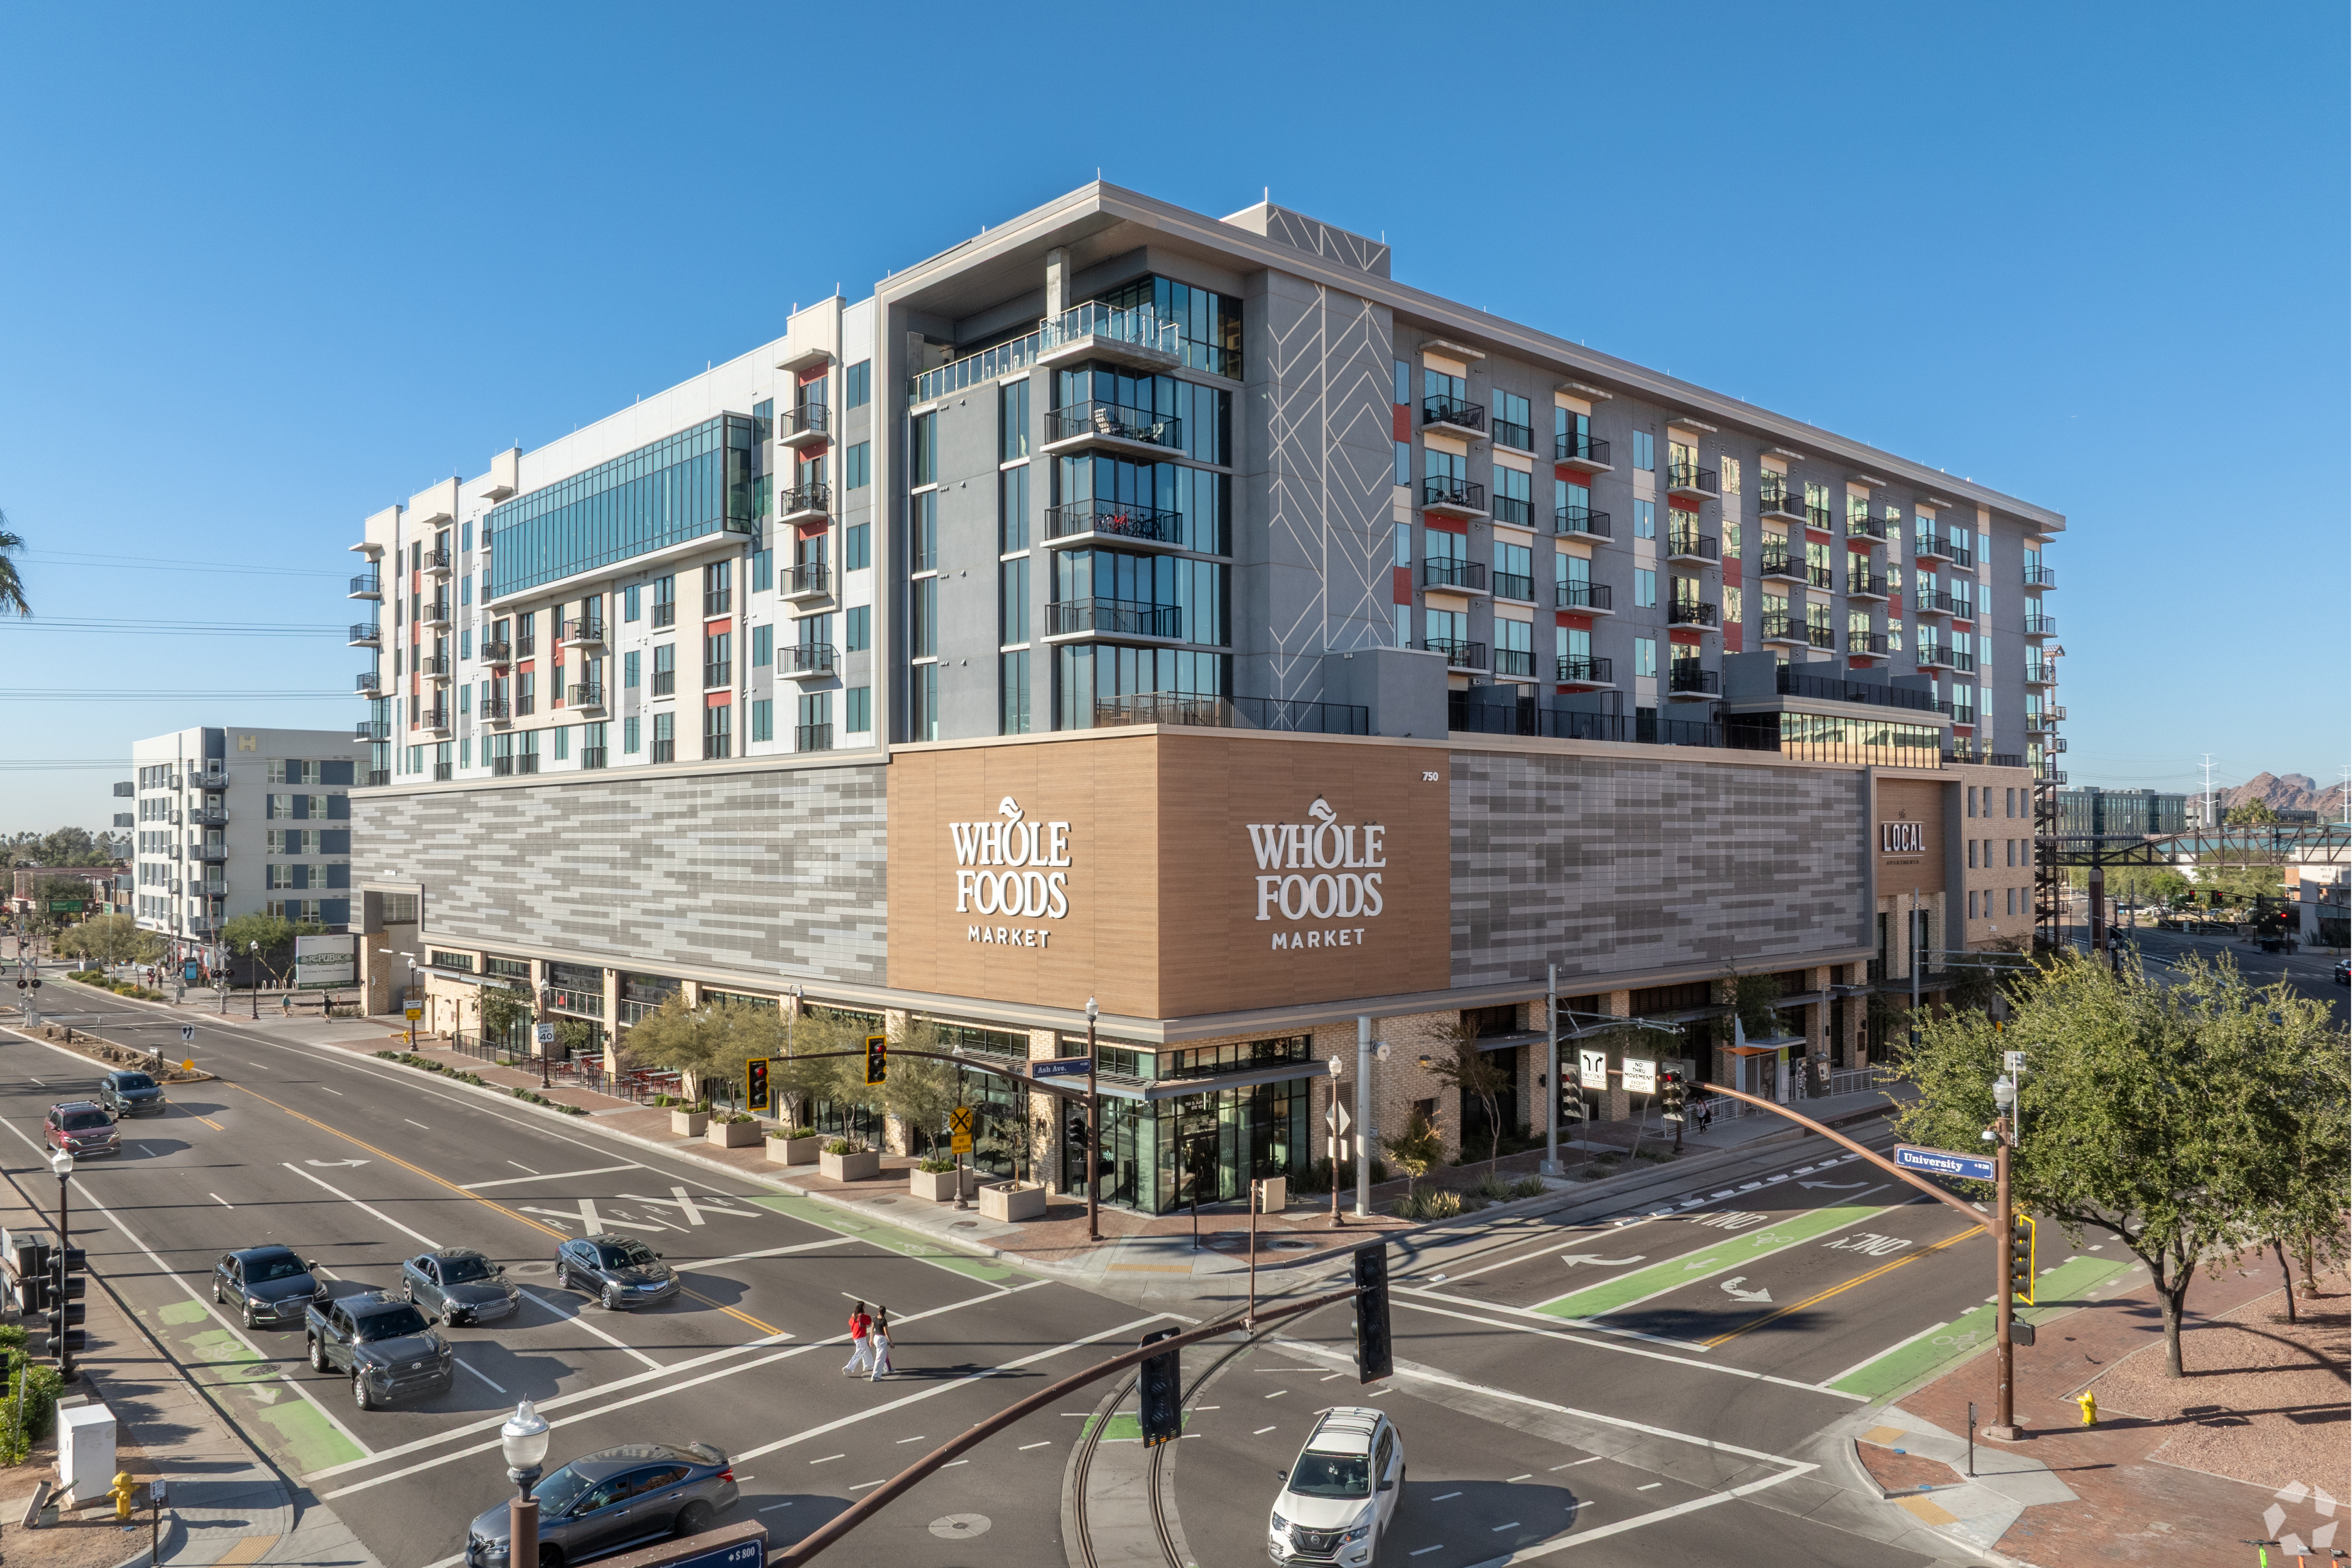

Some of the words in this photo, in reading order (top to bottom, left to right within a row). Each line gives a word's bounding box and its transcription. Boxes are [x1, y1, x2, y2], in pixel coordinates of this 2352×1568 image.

[1422, 771, 1439, 781] 750
[949, 821, 1073, 867] WHOLE
[1245, 823, 1387, 870] WHOLE
[1883, 824, 1926, 852] LOCAL
[956, 870, 1069, 920] FOODS
[1255, 872, 1383, 921] FOODS
[968, 925, 1051, 948] MARKET
[1271, 928, 1365, 950] MARKET
[1625, 1072, 1653, 1081] MOVEMENT
[1903, 1152, 1963, 1172] University
[1683, 1208, 1768, 1229] ONLY
[1821, 1232, 1912, 1256] ONLY
[736, 1552, 740, 1560] S
[742, 1546, 755, 1559] 800
